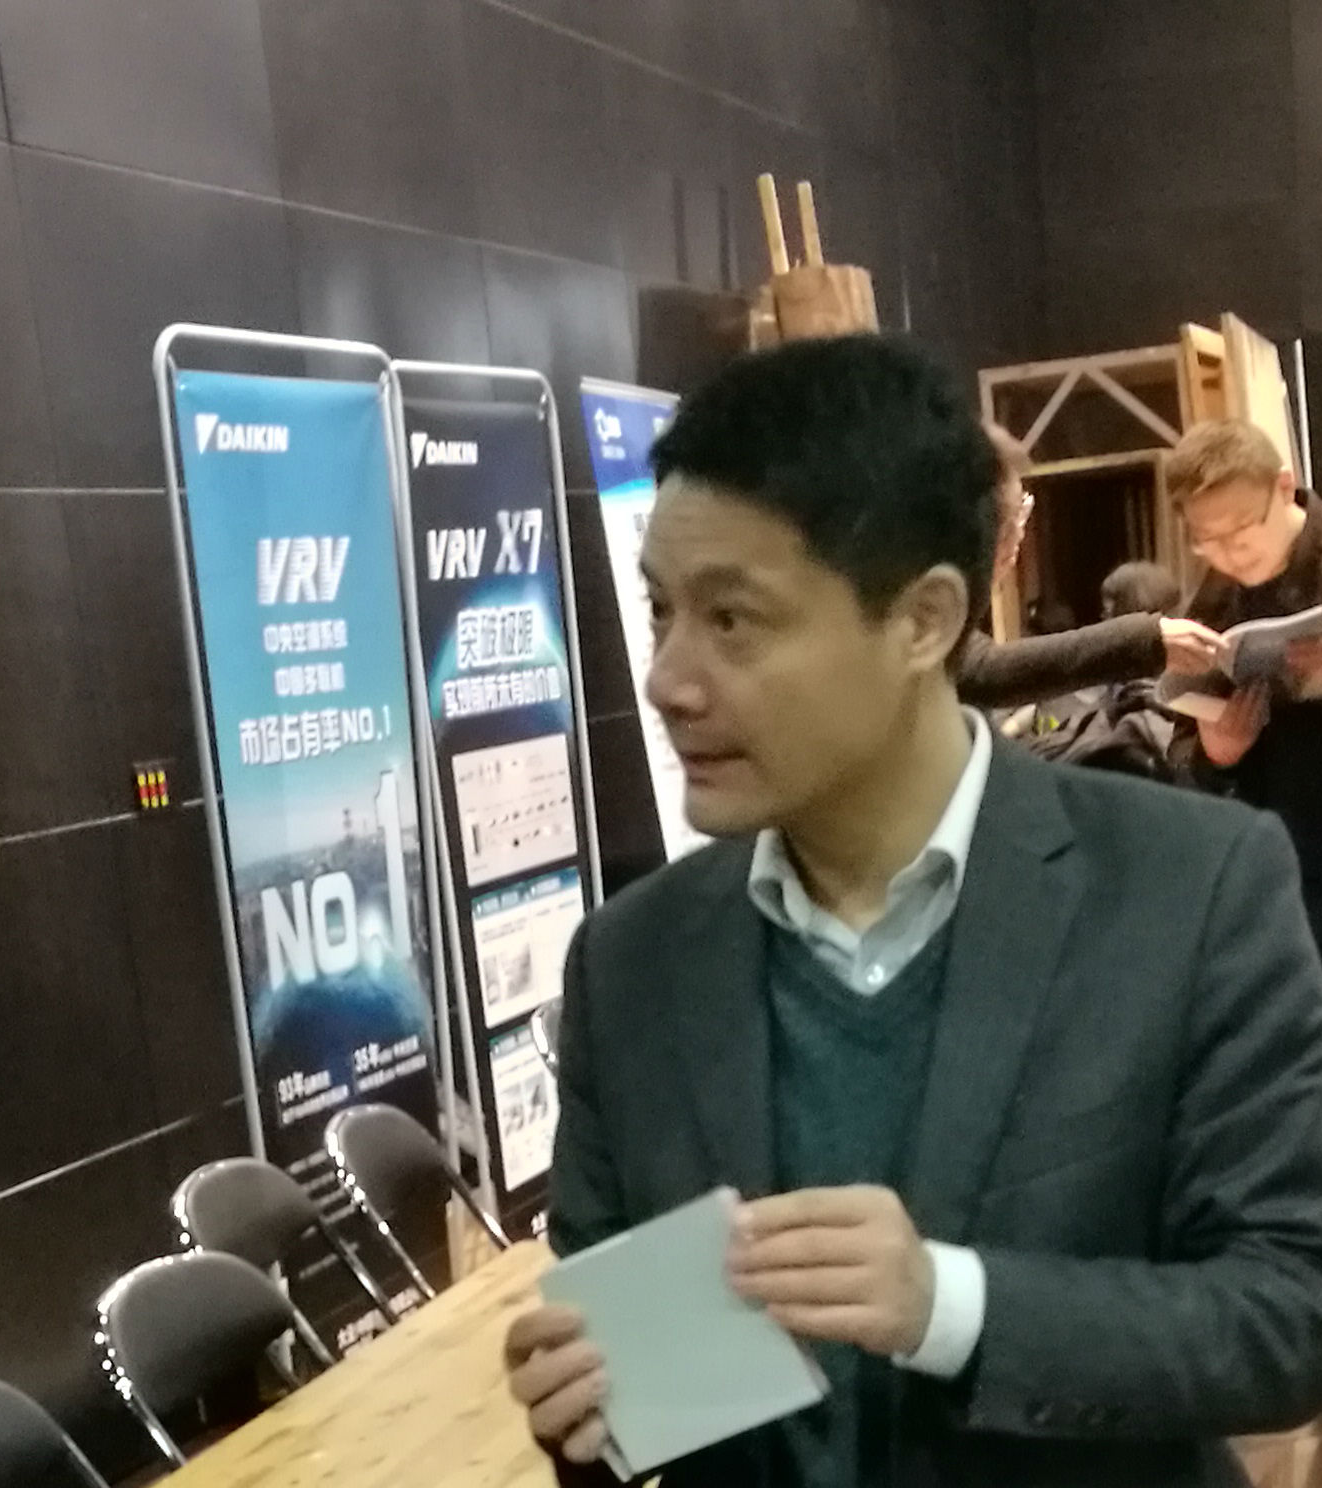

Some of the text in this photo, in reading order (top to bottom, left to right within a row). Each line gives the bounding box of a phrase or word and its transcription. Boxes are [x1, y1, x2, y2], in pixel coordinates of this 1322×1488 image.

[217, 424, 289, 453] DAIKIN
[426, 440, 478, 466] DAIKIN
[427, 508, 543, 581] VRV X7
[258, 535, 351, 606] VRV
